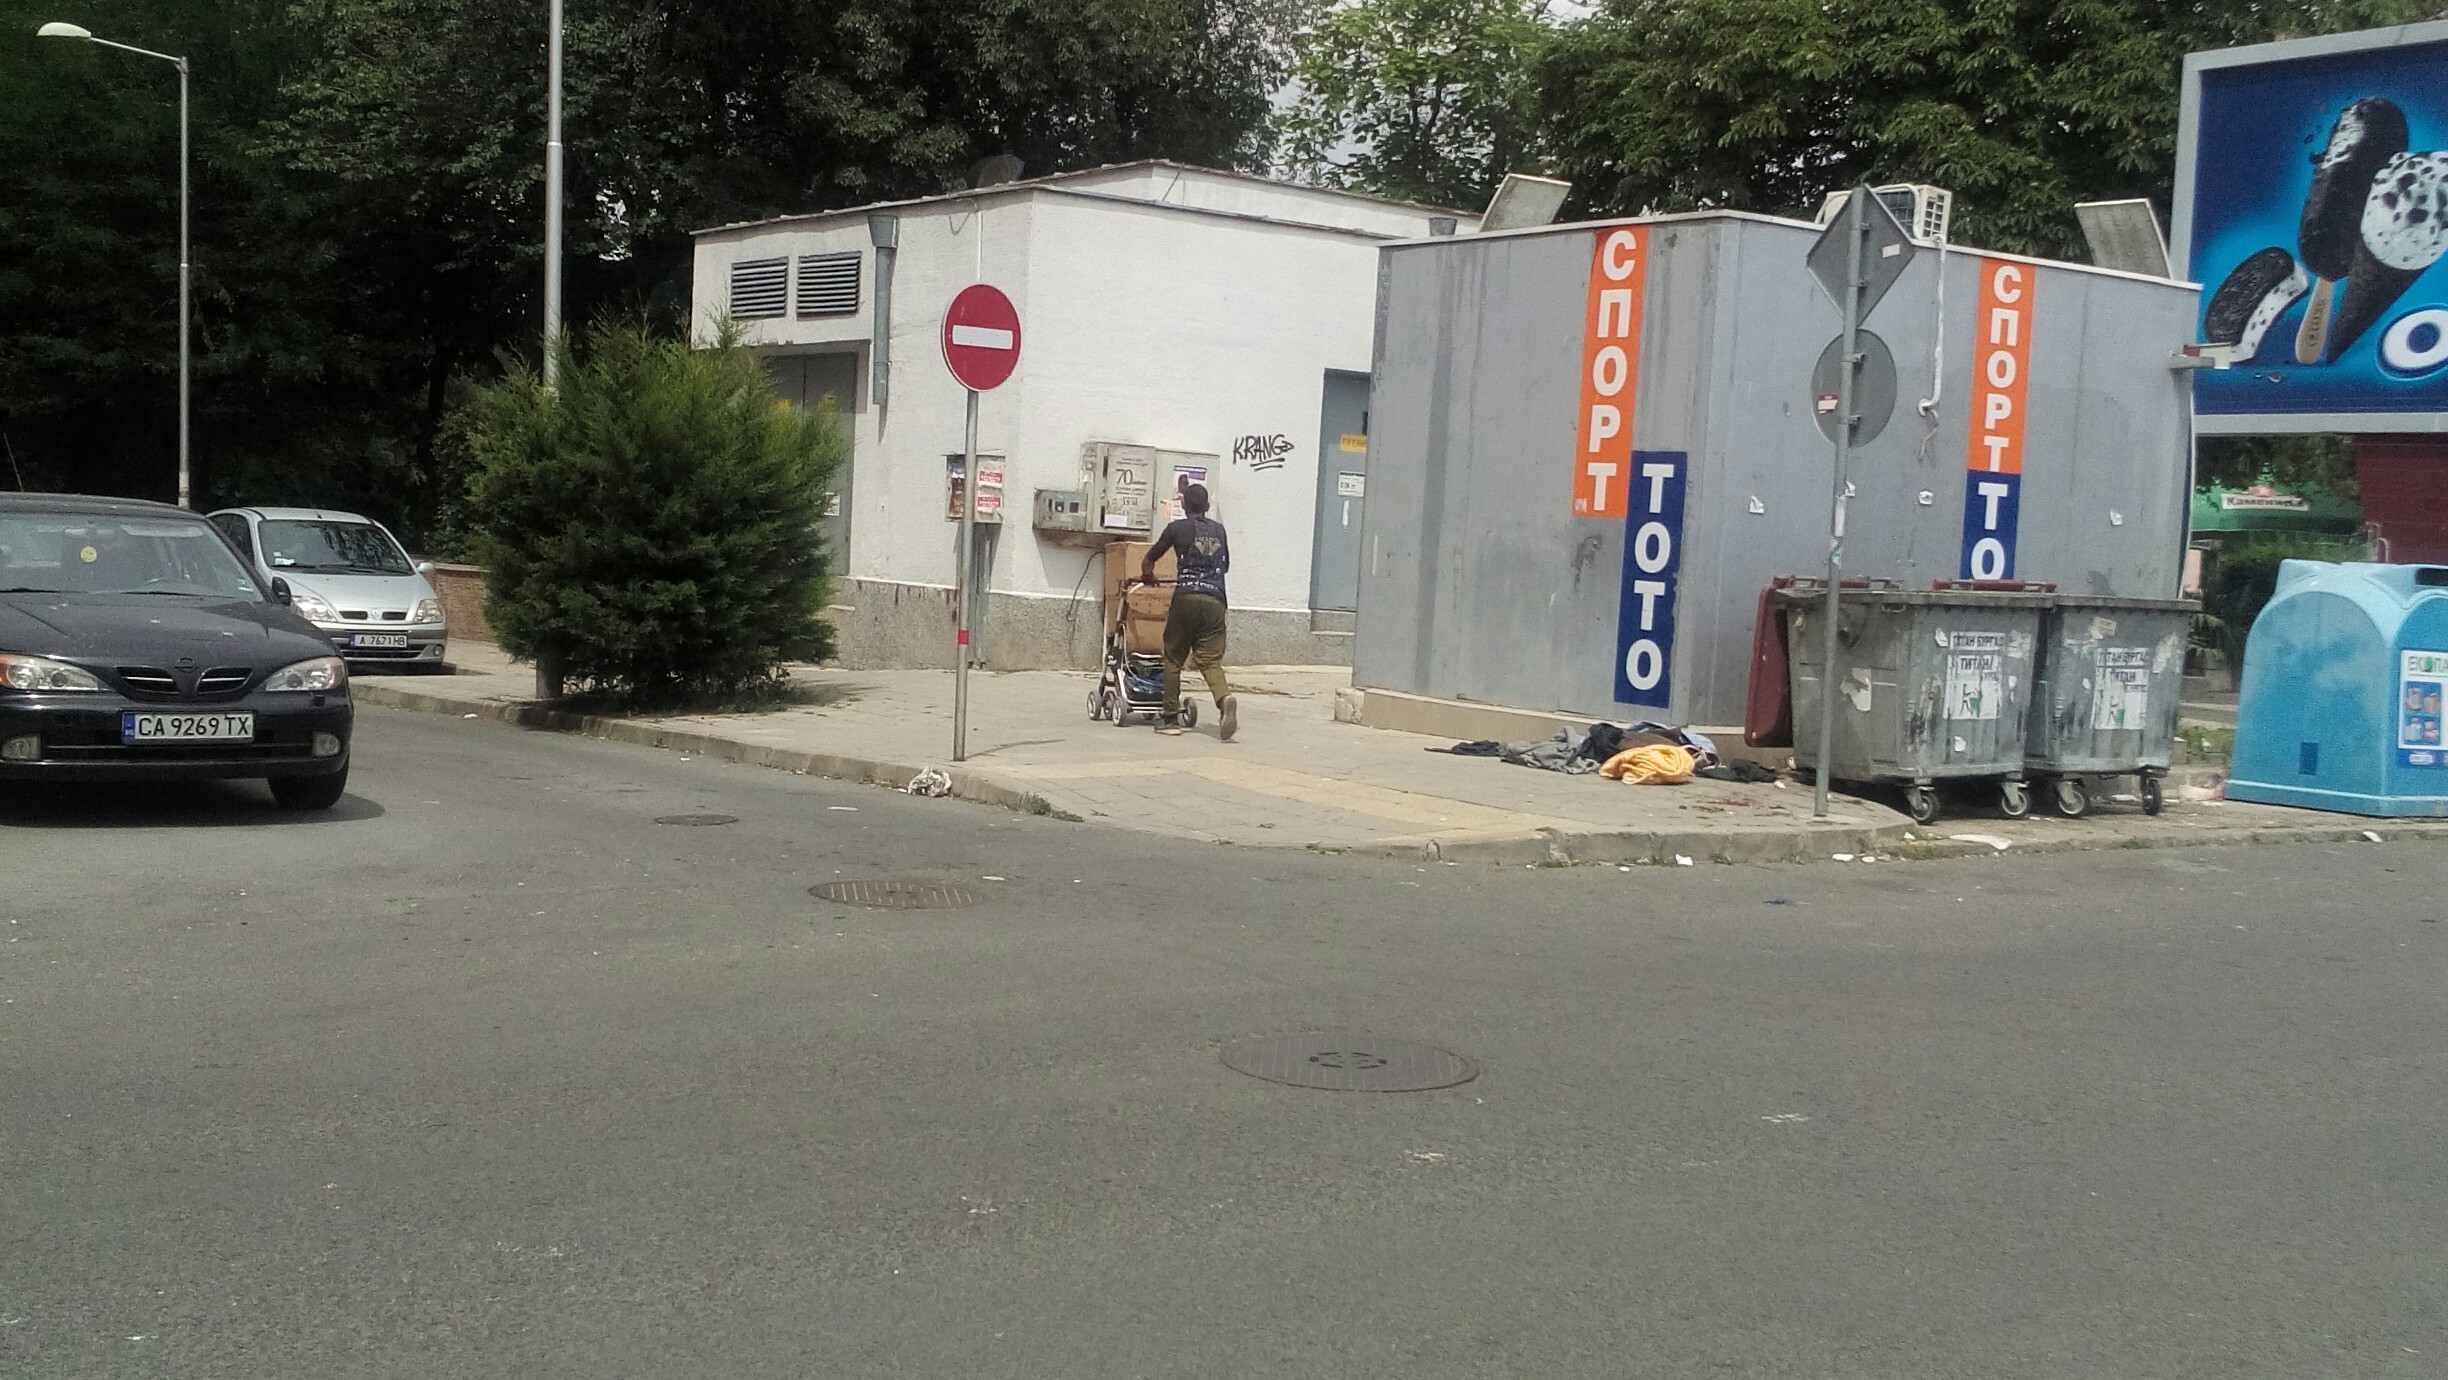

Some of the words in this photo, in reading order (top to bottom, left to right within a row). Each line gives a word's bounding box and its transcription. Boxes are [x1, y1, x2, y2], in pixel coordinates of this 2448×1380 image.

[1586, 230, 1637, 513] СПОРТ
[1982, 265, 2023, 473] СПОРТ
[1115, 468, 1134, 486] 70
[1625, 463, 1675, 691] ТОТО
[138, 716, 166, 737] CA
[170, 716, 220, 736] 9269
[223, 716, 249, 736] TX
